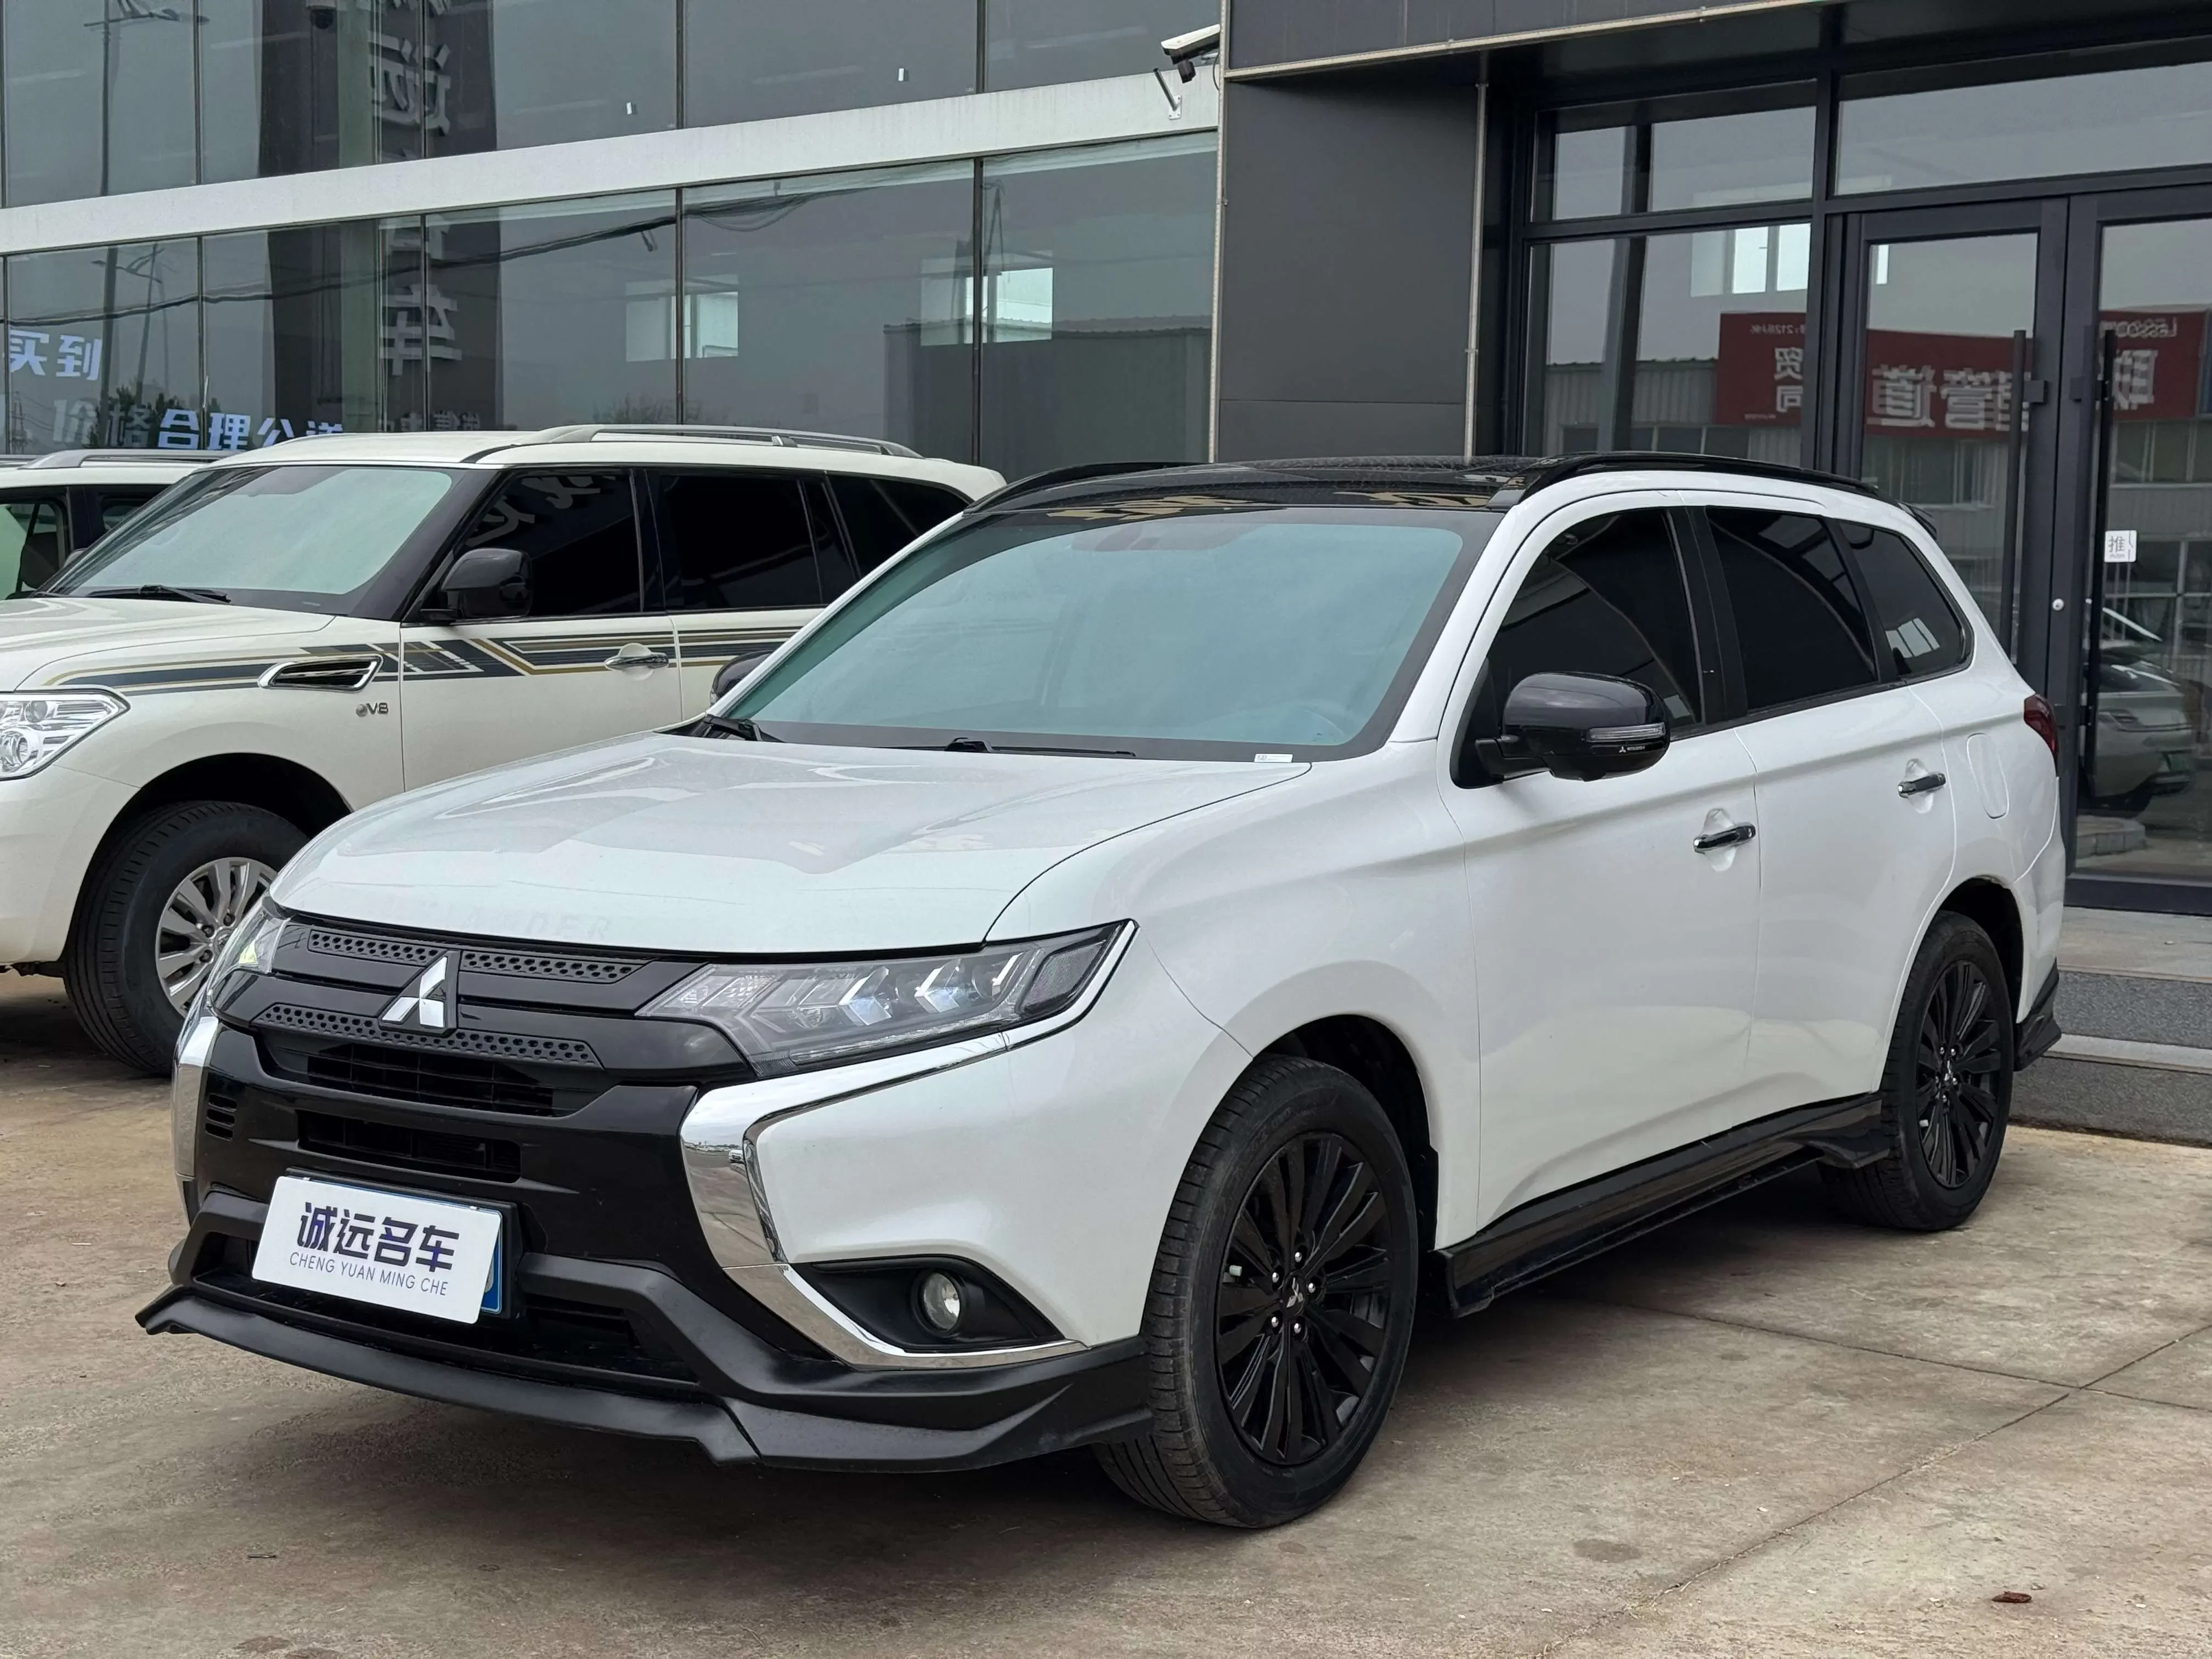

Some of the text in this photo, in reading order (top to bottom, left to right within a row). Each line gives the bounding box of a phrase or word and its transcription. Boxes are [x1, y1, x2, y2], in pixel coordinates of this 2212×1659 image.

[10, 329, 103, 381] 买到
[2108, 535, 2125, 552] 推
[297, 1202, 459, 1272] 诚远名车
[290, 1252, 449, 1296] CHENG YUAN MING CHE
